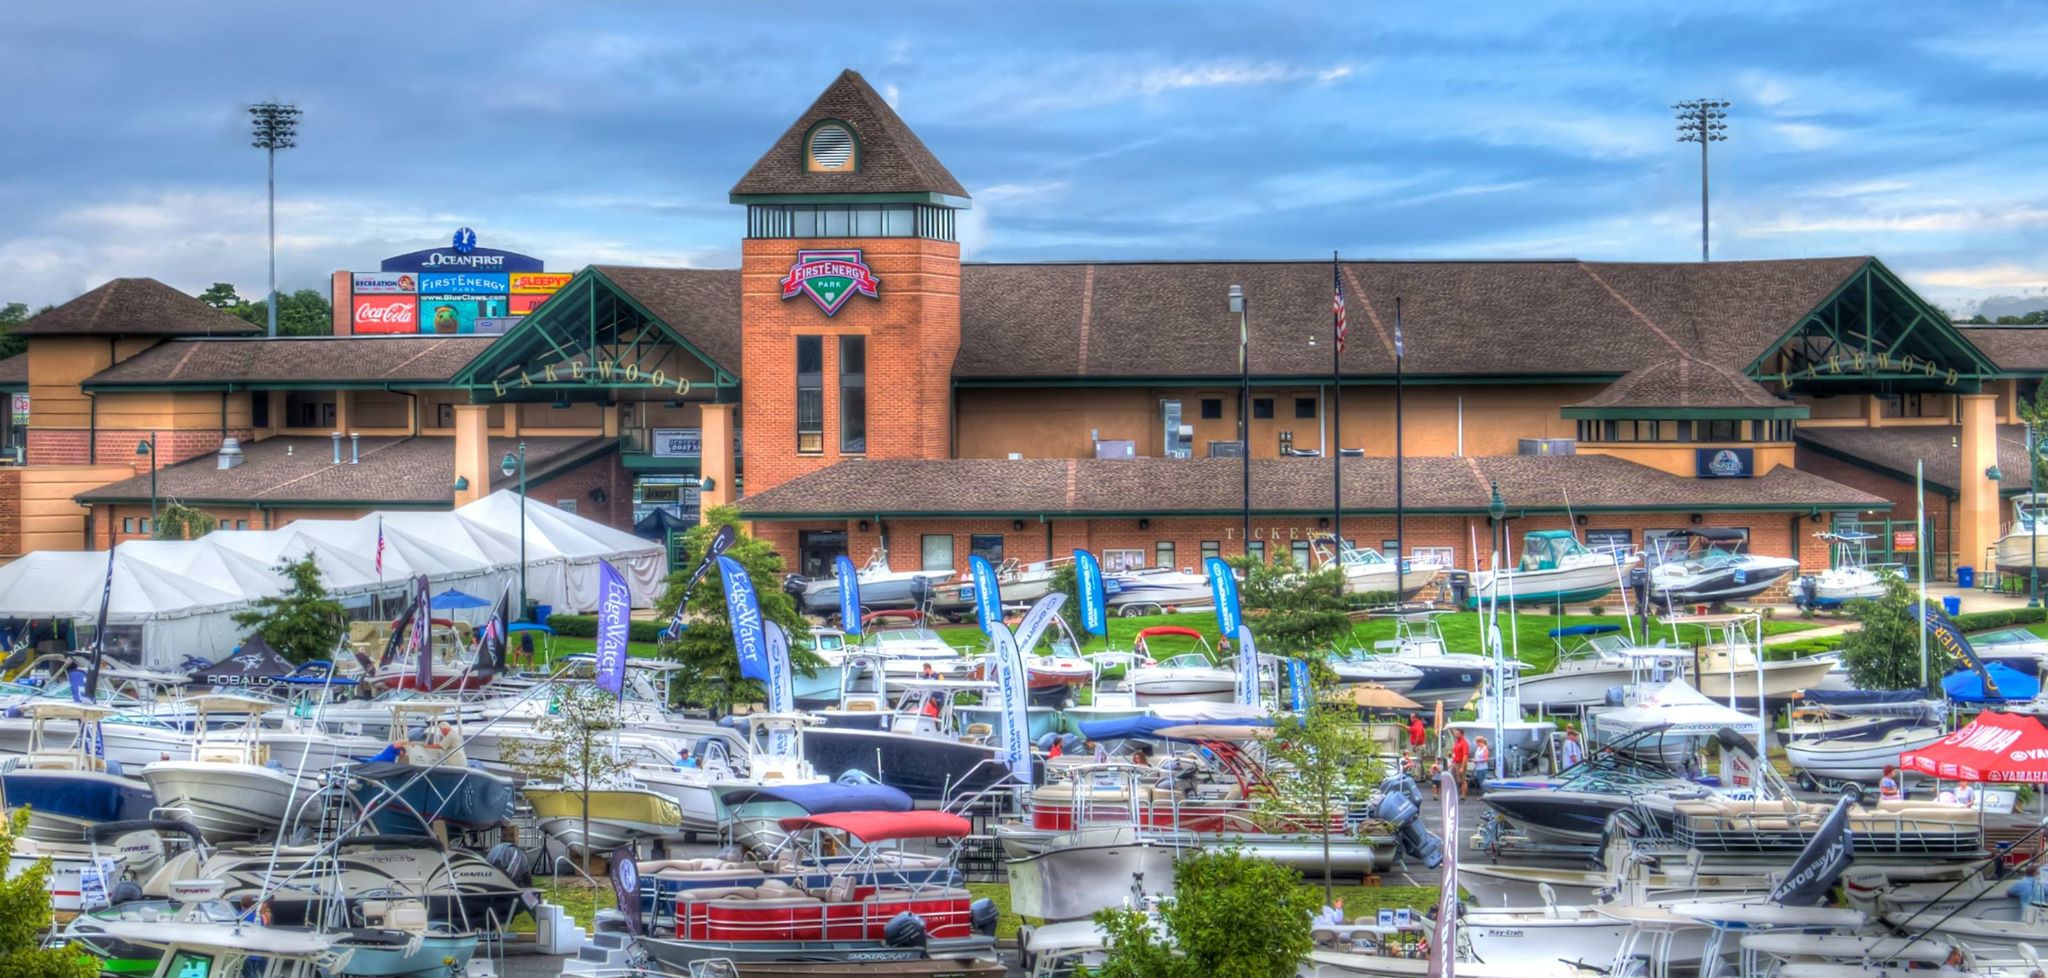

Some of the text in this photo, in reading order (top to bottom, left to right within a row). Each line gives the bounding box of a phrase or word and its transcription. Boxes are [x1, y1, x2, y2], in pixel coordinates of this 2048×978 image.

[422, 274, 505, 291] FIRSTENERGY
[795, 262, 866, 281] FIRSTENERGY
[492, 360, 690, 398] LAKEWOOD
[1781, 352, 1958, 390] LAKEWOOD
[602, 580, 628, 676] EdgeWater
[729, 572, 759, 661] EdgeWater
[453, 870, 493, 880] CARAVELLE
[1774, 868, 1815, 901] BOATS
[175, 887, 211, 895] Raymarine
[847, 951, 913, 961] SMOKERCRAFT
